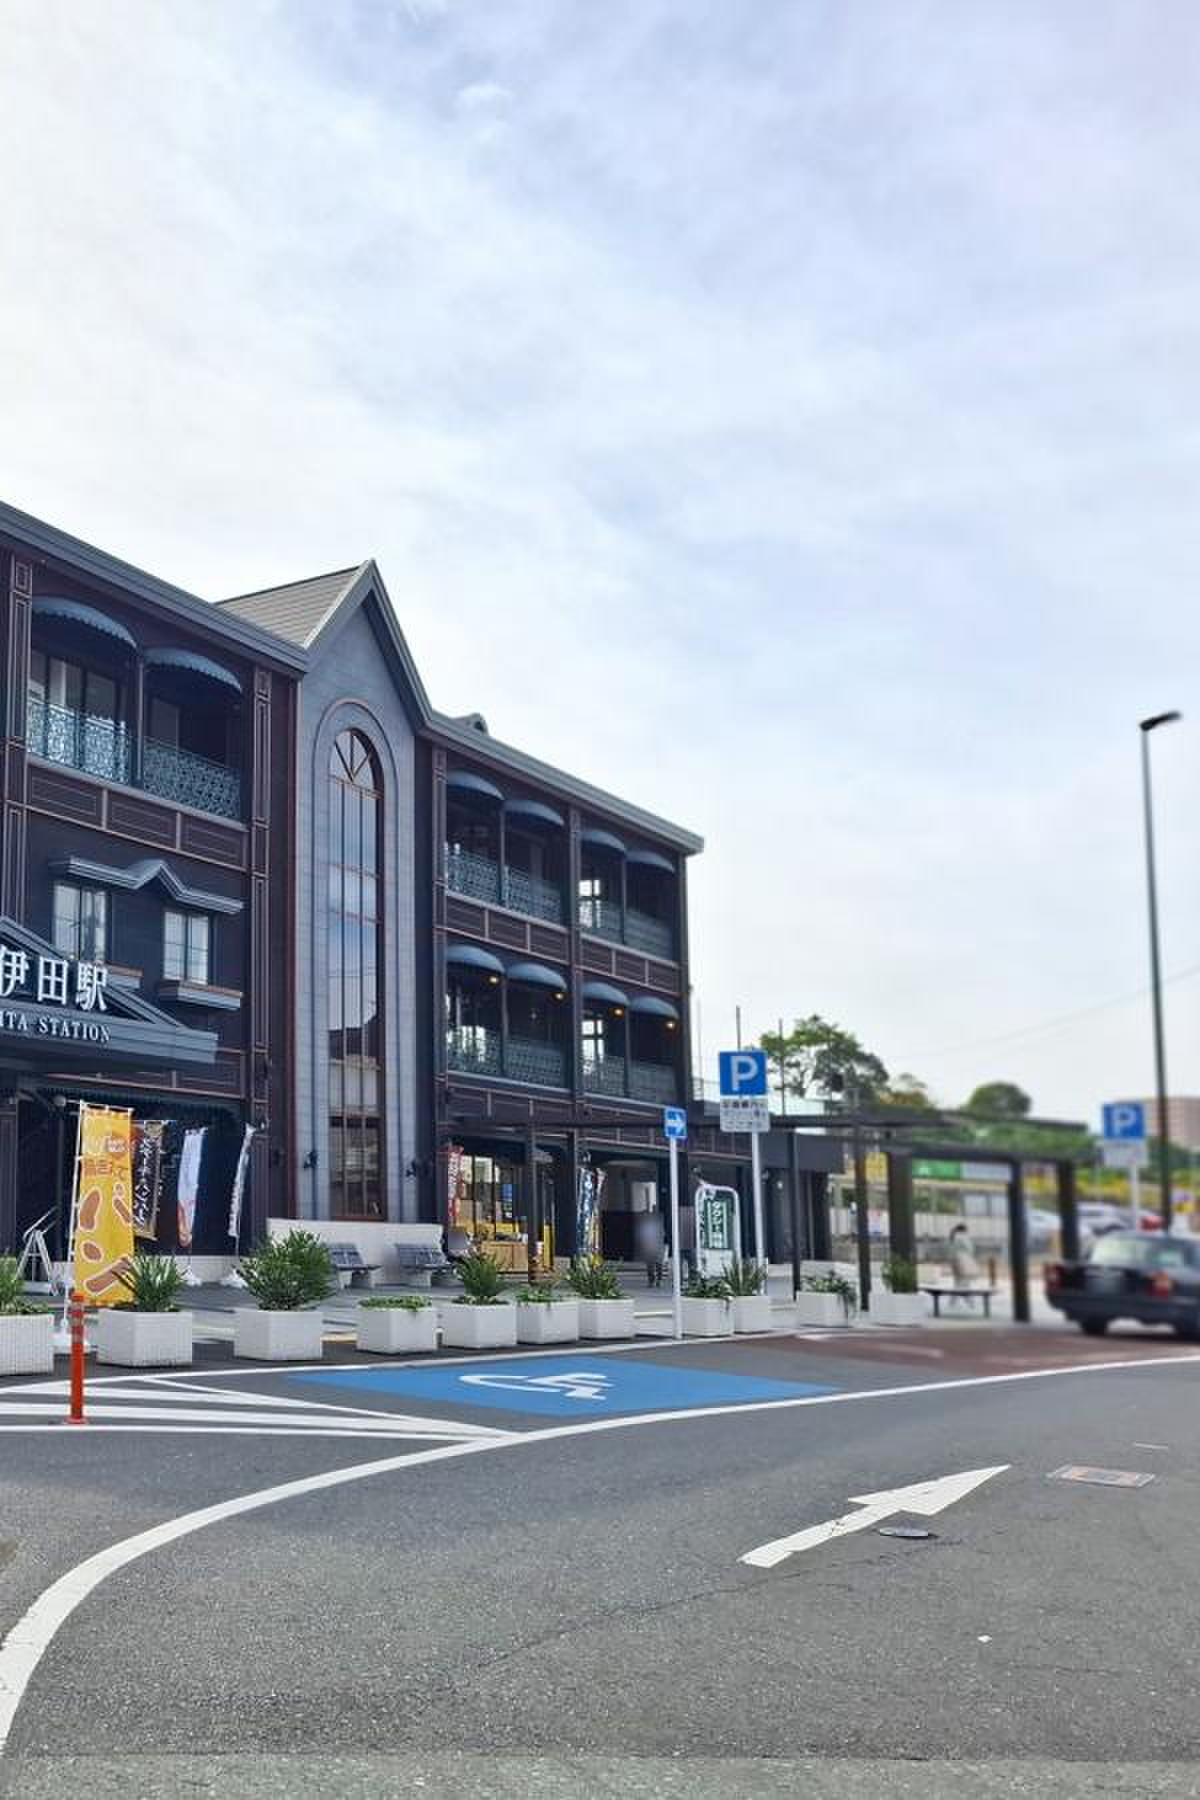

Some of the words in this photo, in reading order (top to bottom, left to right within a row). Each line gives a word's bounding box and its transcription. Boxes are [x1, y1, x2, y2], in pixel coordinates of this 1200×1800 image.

[0, 1010, 28, 1031] ITA
[39, 1016, 111, 1042] STATION
[730, 1055, 758, 1091] P
[1113, 1107, 1136, 1135] P
